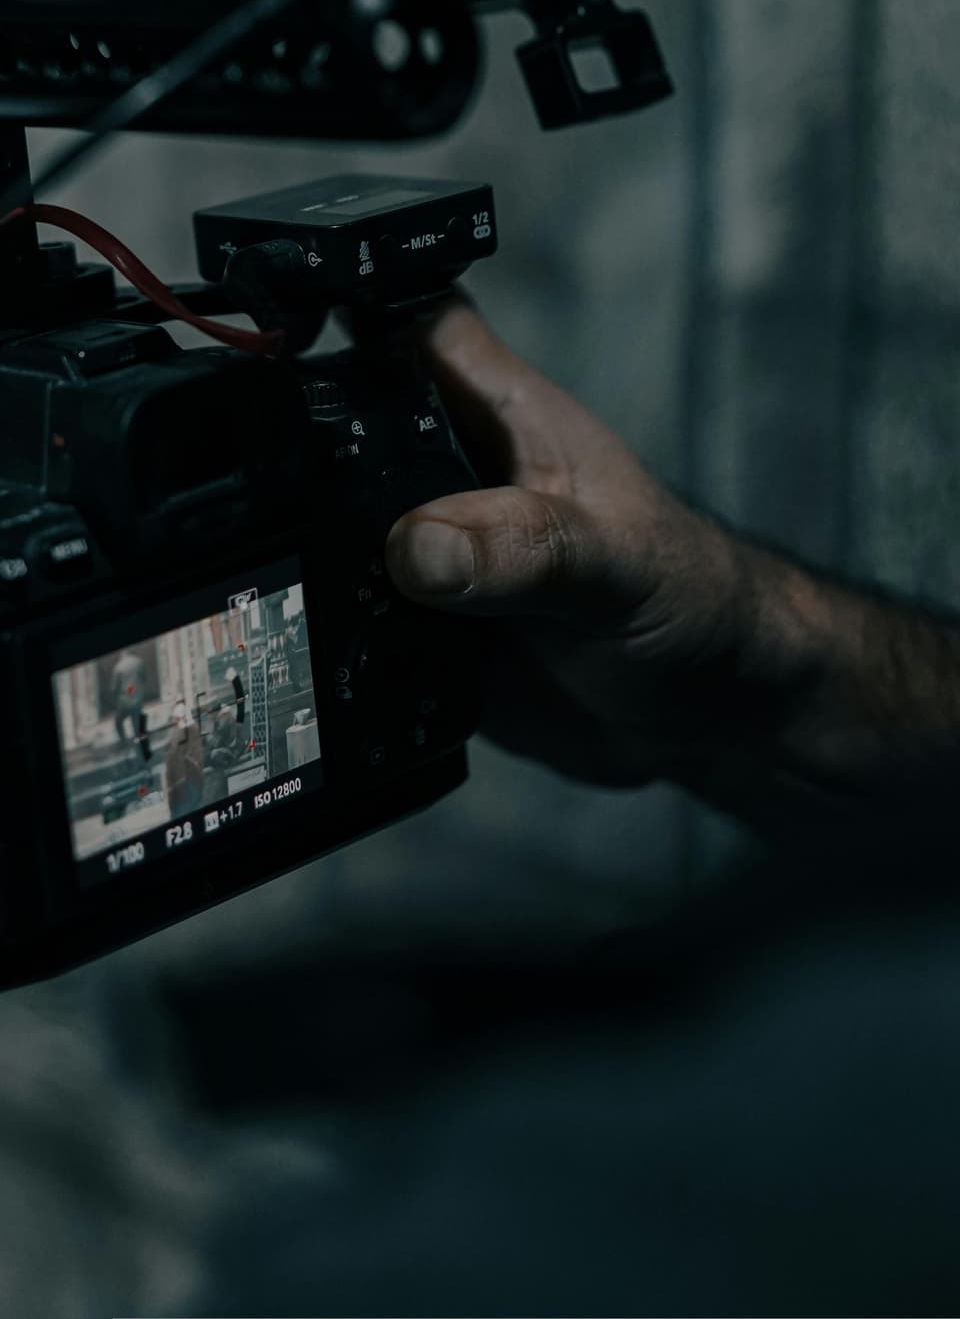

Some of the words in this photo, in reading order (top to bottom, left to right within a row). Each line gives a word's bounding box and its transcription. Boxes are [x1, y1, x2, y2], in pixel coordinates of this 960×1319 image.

[472, 211, 489, 226] 1/2
[359, 261, 374, 275] dB
[418, 415, 438, 432] AEL
[106, 842, 145, 873] 1/100
[165, 821, 193, 849] F2.8
